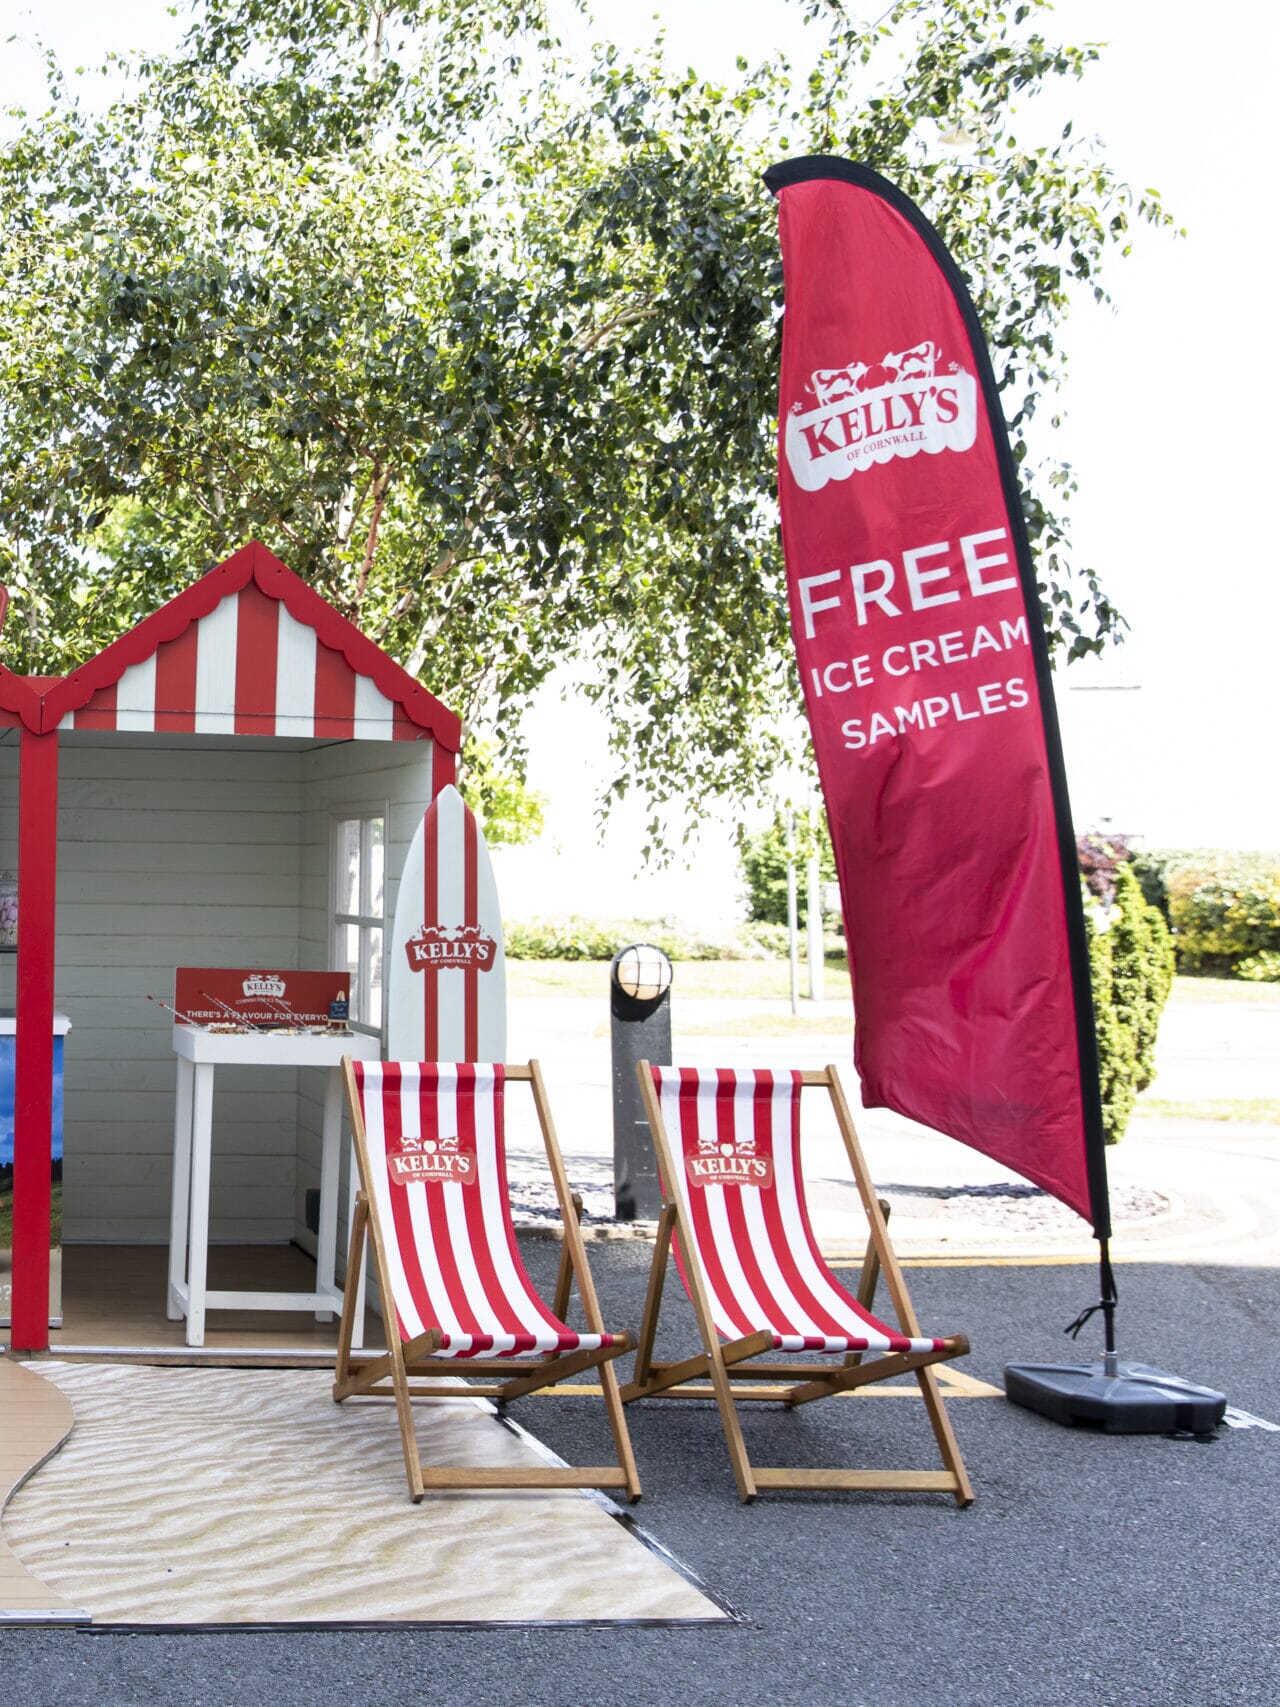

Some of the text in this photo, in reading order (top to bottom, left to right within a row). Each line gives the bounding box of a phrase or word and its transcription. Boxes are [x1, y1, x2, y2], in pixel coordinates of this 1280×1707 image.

[799, 386, 960, 462] KELLY'S
[846, 431, 927, 462] OF CORNWALL
[798, 527, 1018, 640] FREE
[811, 616, 1030, 698] ICE CREAM
[841, 678, 1029, 749] SAMPLES
[413, 942, 489, 960] KELLY'S
[247, 982, 282, 991] KELLY'S
[186, 1010, 221, 1018] THERE'S
[274, 1012, 292, 1020] FOR
[294, 1013, 328, 1021] EVERYO
[394, 1154, 470, 1174] KELLY'S
[691, 1157, 767, 1177] KELLY'S
